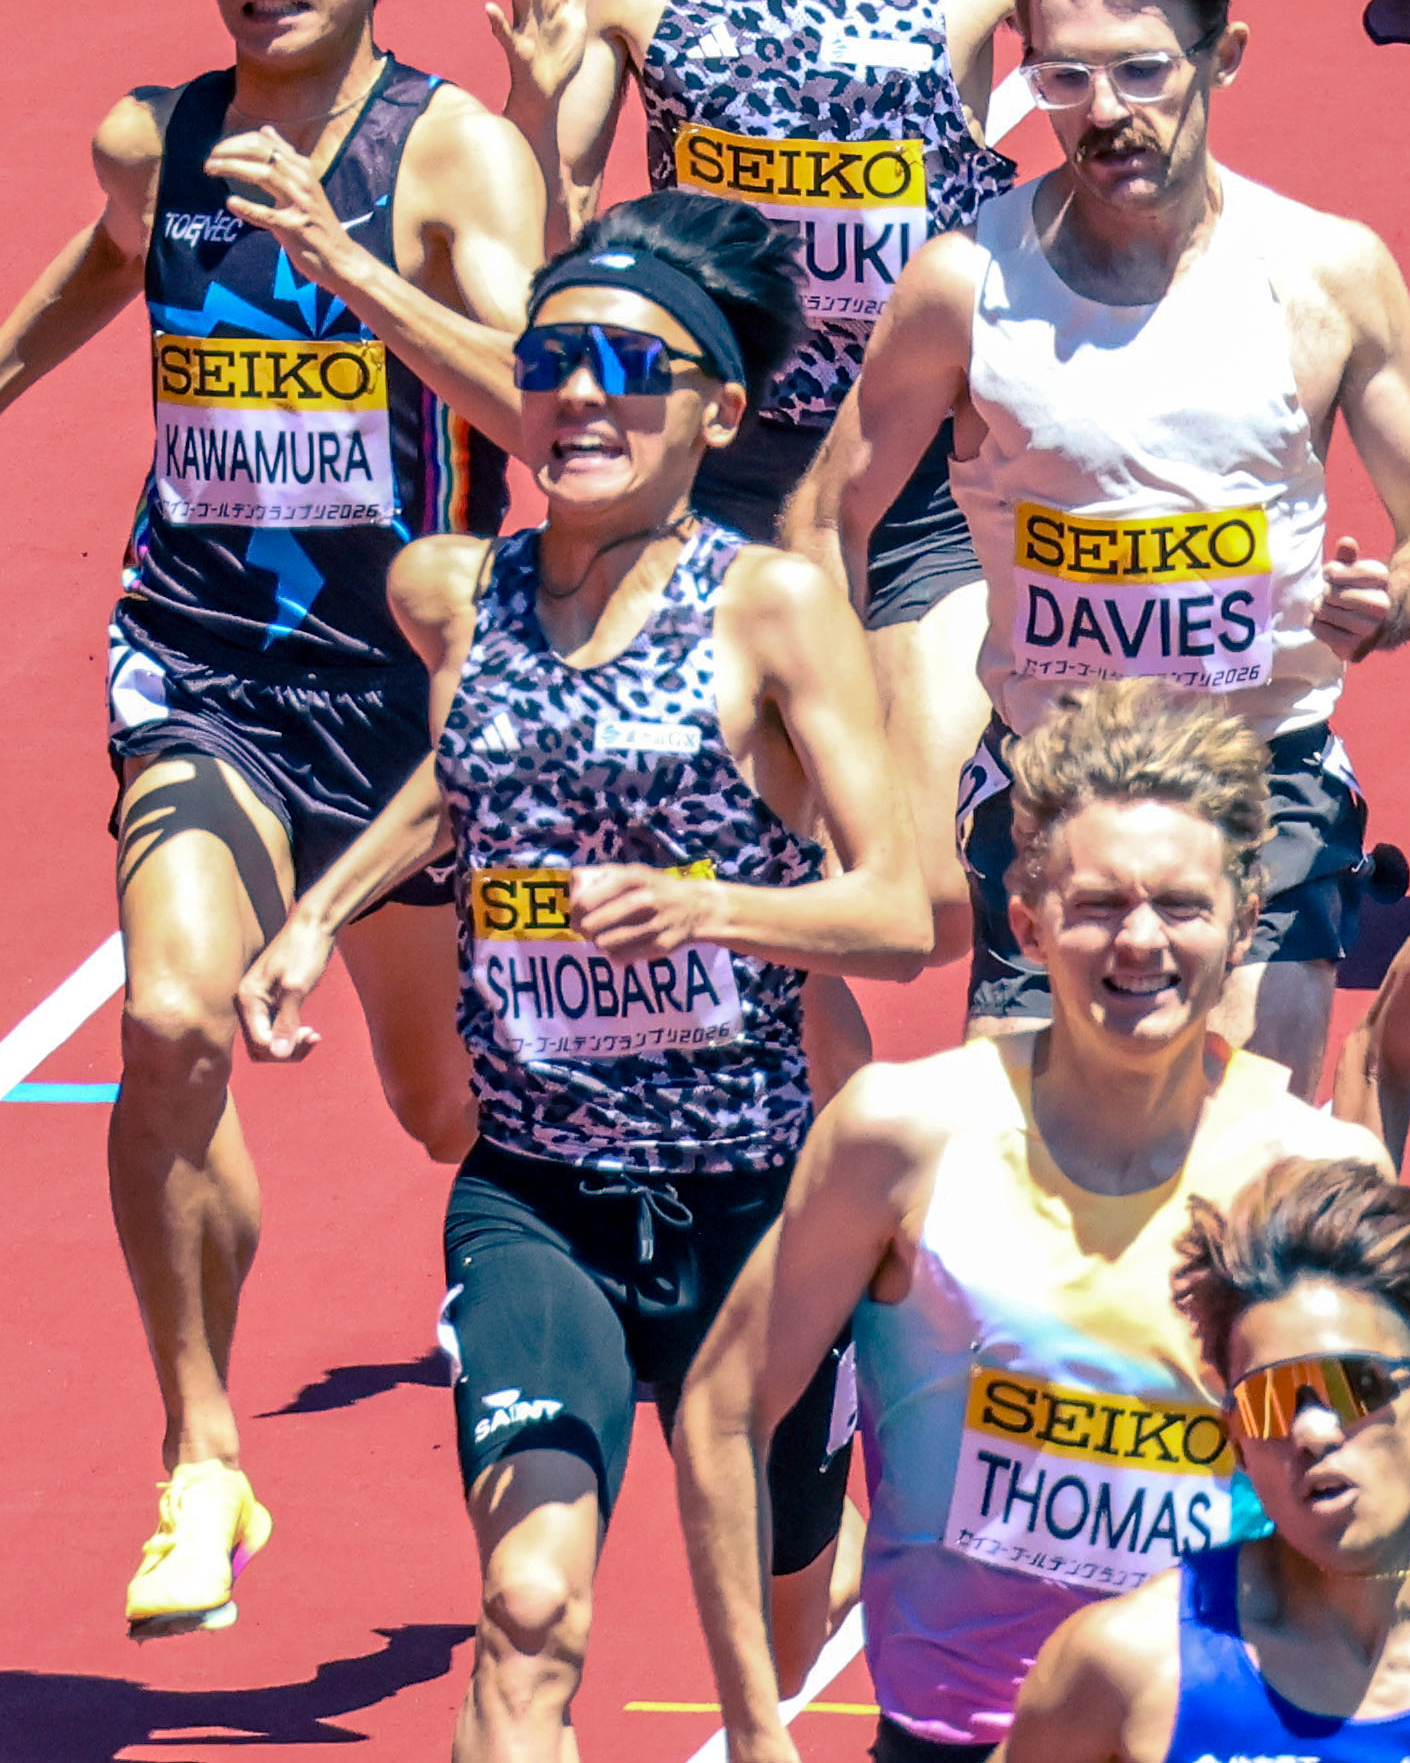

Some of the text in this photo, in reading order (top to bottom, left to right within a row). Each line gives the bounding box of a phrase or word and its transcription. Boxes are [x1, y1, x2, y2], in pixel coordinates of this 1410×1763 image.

[688, 136, 911, 200] SEIKO
[802, 220, 909, 284] UKI
[160, 345, 371, 401] SEIKO
[166, 424, 373, 485] KAWAMURA
[1026, 515, 1255, 575] SEIKO
[1025, 584, 1256, 658] DAVIES
[487, 949, 721, 1020] SHIOBARA
[983, 1380, 1228, 1465] SEIKO
[977, 1449, 1212, 1557] THOMAS
